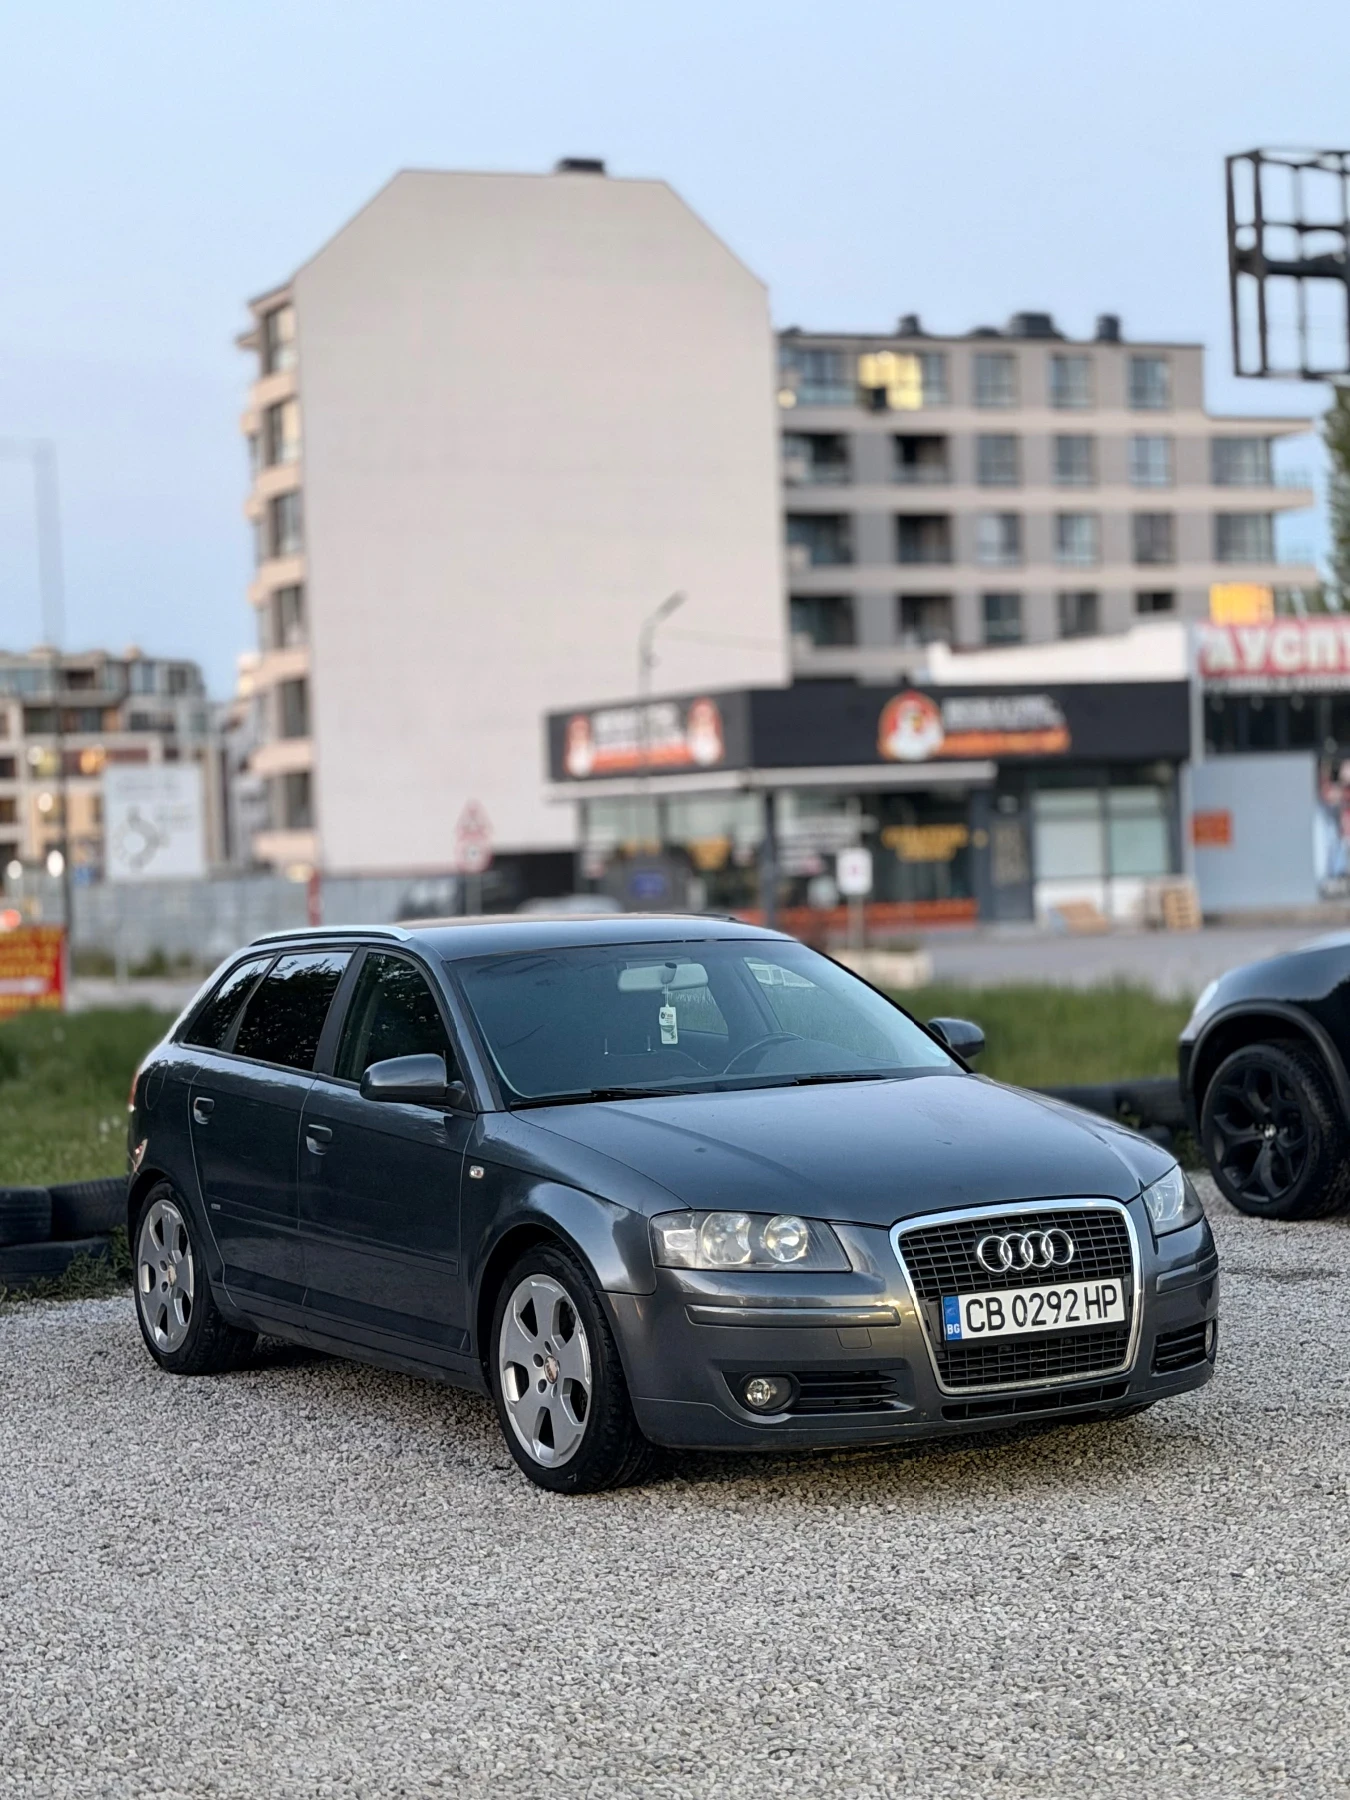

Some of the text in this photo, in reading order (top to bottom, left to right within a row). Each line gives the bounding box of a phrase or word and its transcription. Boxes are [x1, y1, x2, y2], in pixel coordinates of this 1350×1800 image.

[965, 1284, 1118, 1333] CB 0292 HP
[947, 1323, 961, 1335] BG
